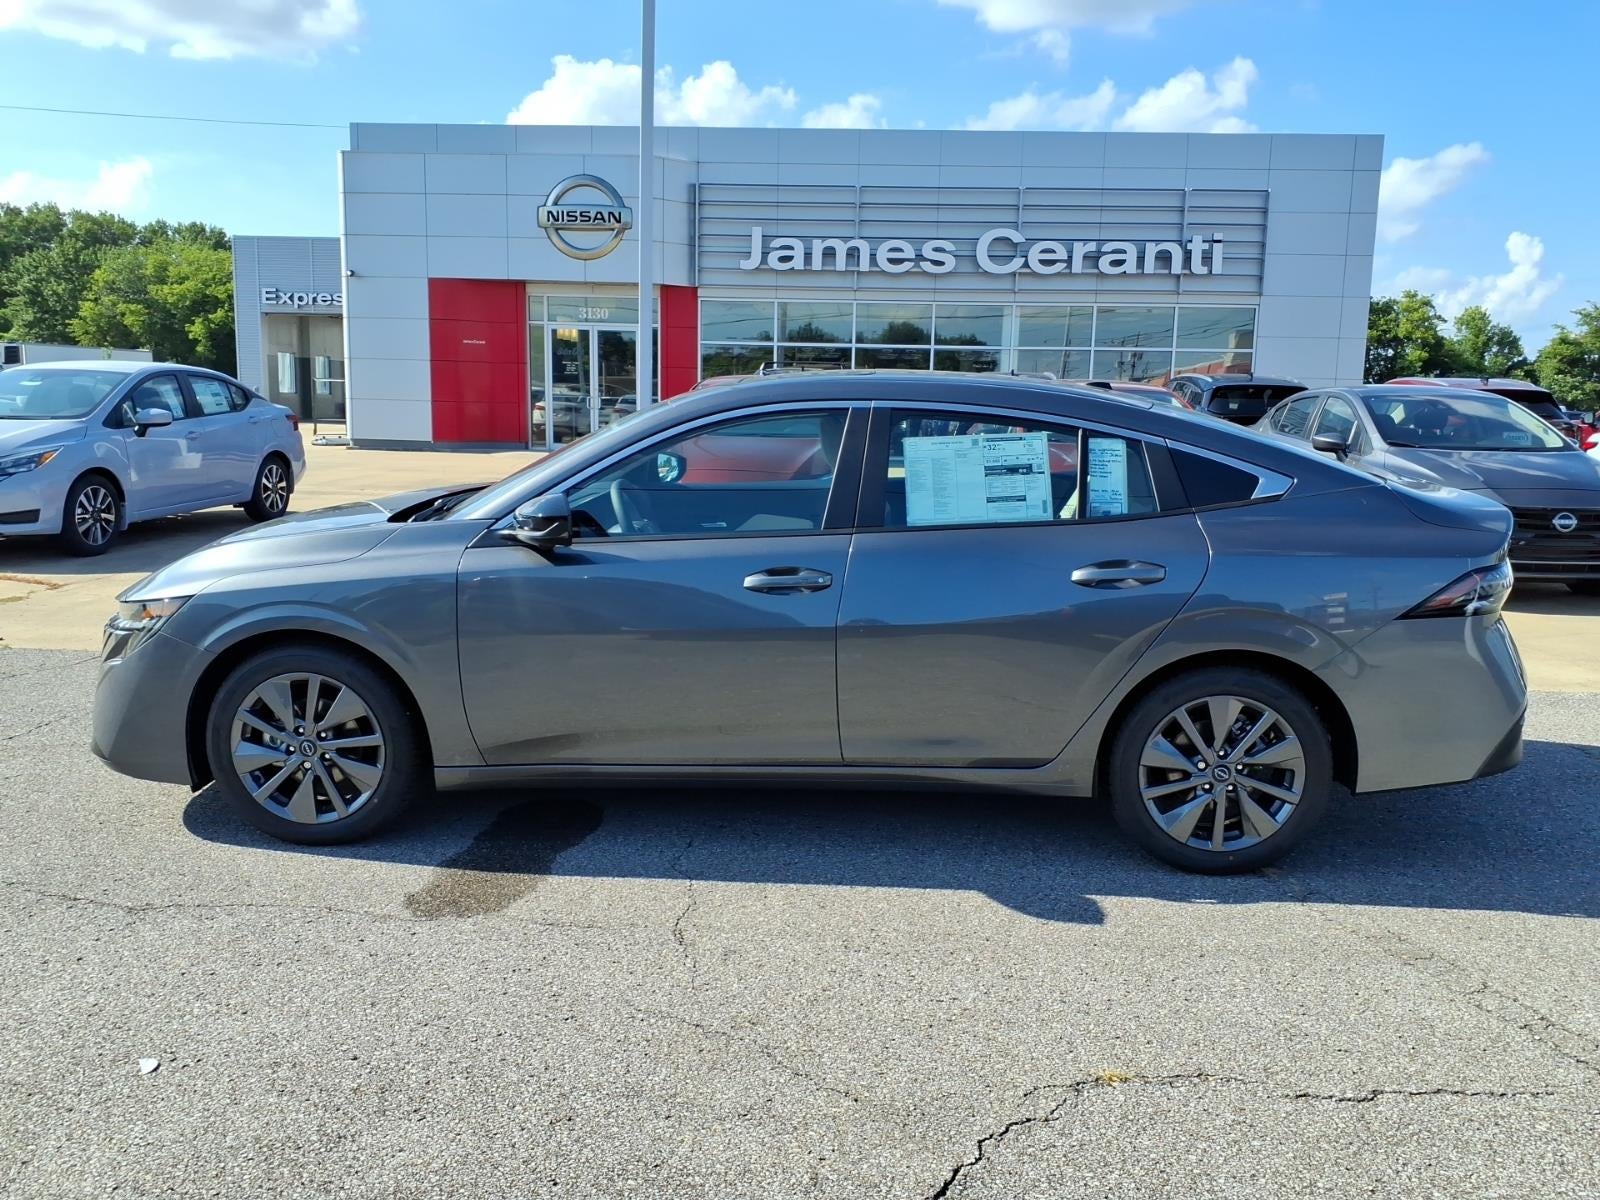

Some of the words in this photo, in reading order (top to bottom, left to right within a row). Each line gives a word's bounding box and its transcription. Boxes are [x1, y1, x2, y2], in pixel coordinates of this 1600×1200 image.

[546, 210, 622, 224] NISSAN
[739, 226, 957, 274] James
[975, 228, 1224, 275] Ceranti
[578, 307, 609, 320] 3130
